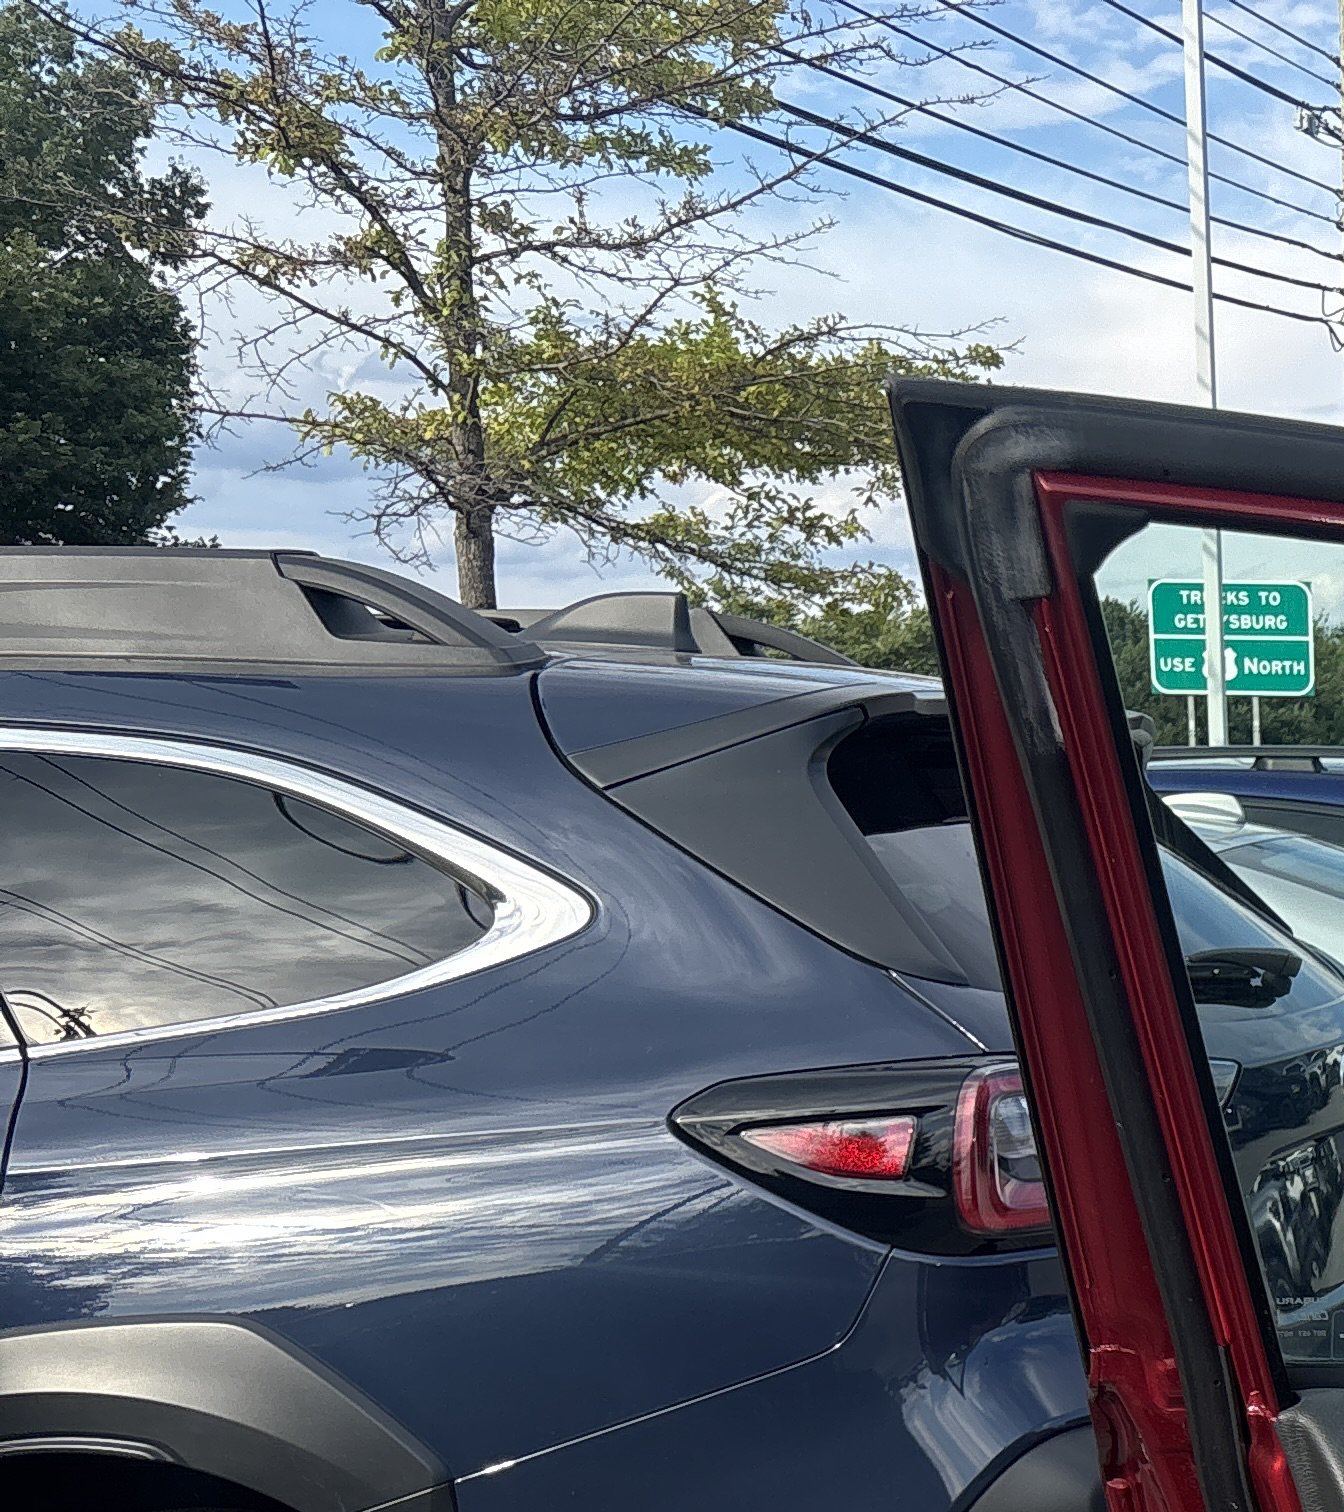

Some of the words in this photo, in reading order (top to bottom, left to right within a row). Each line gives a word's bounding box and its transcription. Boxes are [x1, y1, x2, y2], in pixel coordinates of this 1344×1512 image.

[1179, 590, 1250, 606] TRKS
[1258, 591, 1281, 606] TO
[1174, 613, 1288, 630] GETSBURG
[1159, 657, 1196, 672] USE
[1243, 656, 1305, 675] NORTH
